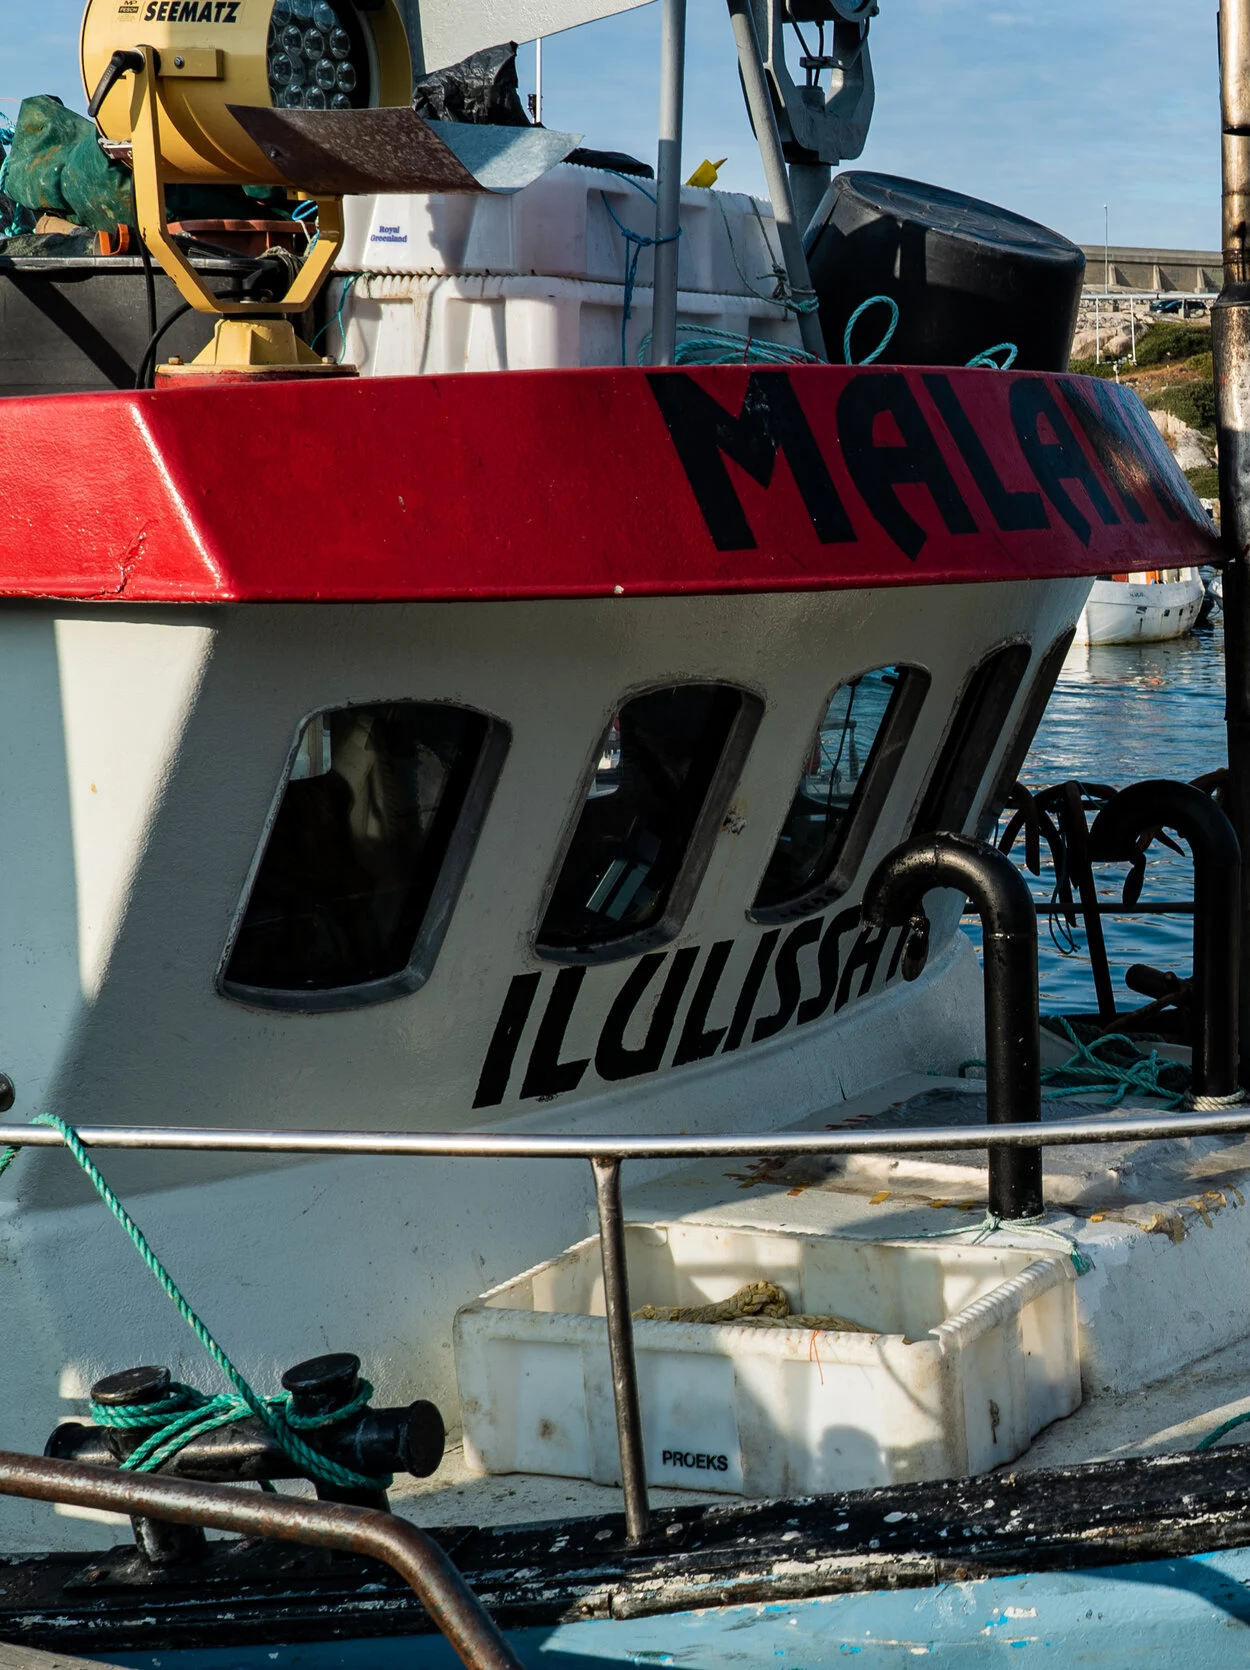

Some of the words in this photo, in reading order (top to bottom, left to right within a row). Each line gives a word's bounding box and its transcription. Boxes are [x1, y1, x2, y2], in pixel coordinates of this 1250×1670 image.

[144, 1, 241, 23] SEEMATZ
[379, 225, 400, 234] Royal
[370, 234, 407, 242] Greenland
[662, 1450, 729, 1471] PROEKS
